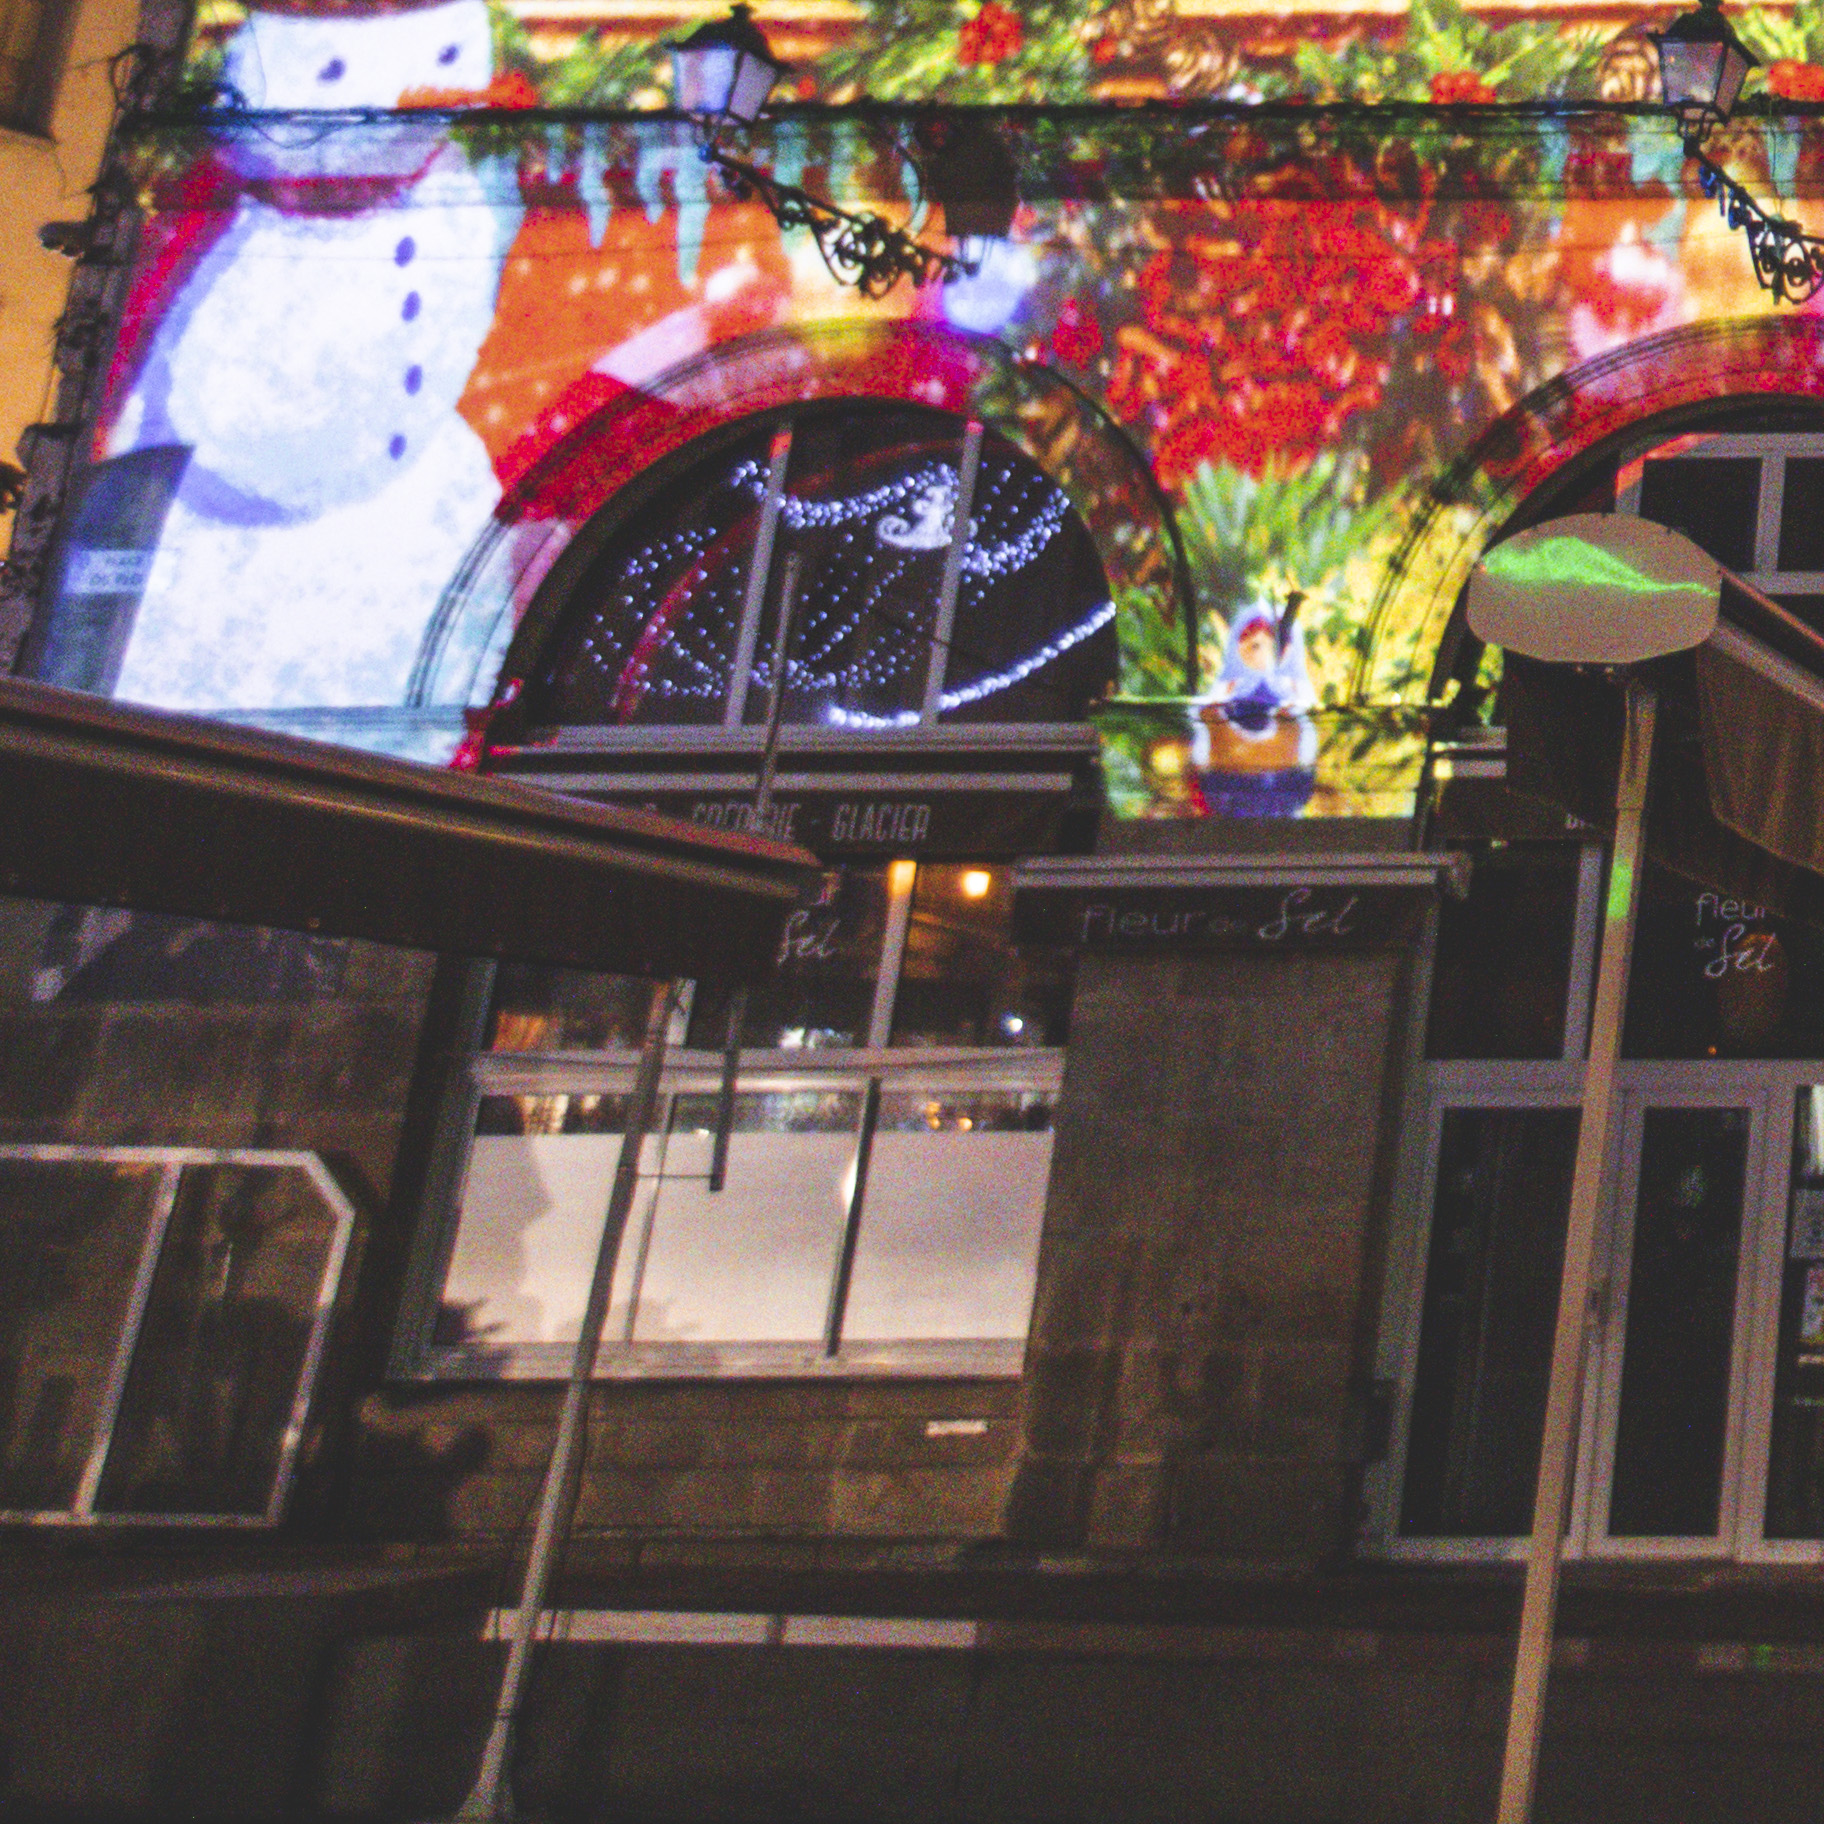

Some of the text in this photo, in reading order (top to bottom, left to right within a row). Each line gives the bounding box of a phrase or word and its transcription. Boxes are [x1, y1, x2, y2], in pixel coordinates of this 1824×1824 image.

[831, 803, 931, 842] GLACIER
[1078, 902, 1208, 944] fleur
[1256, 886, 1361, 941] Sel
[1703, 922, 1778, 979] Sel
